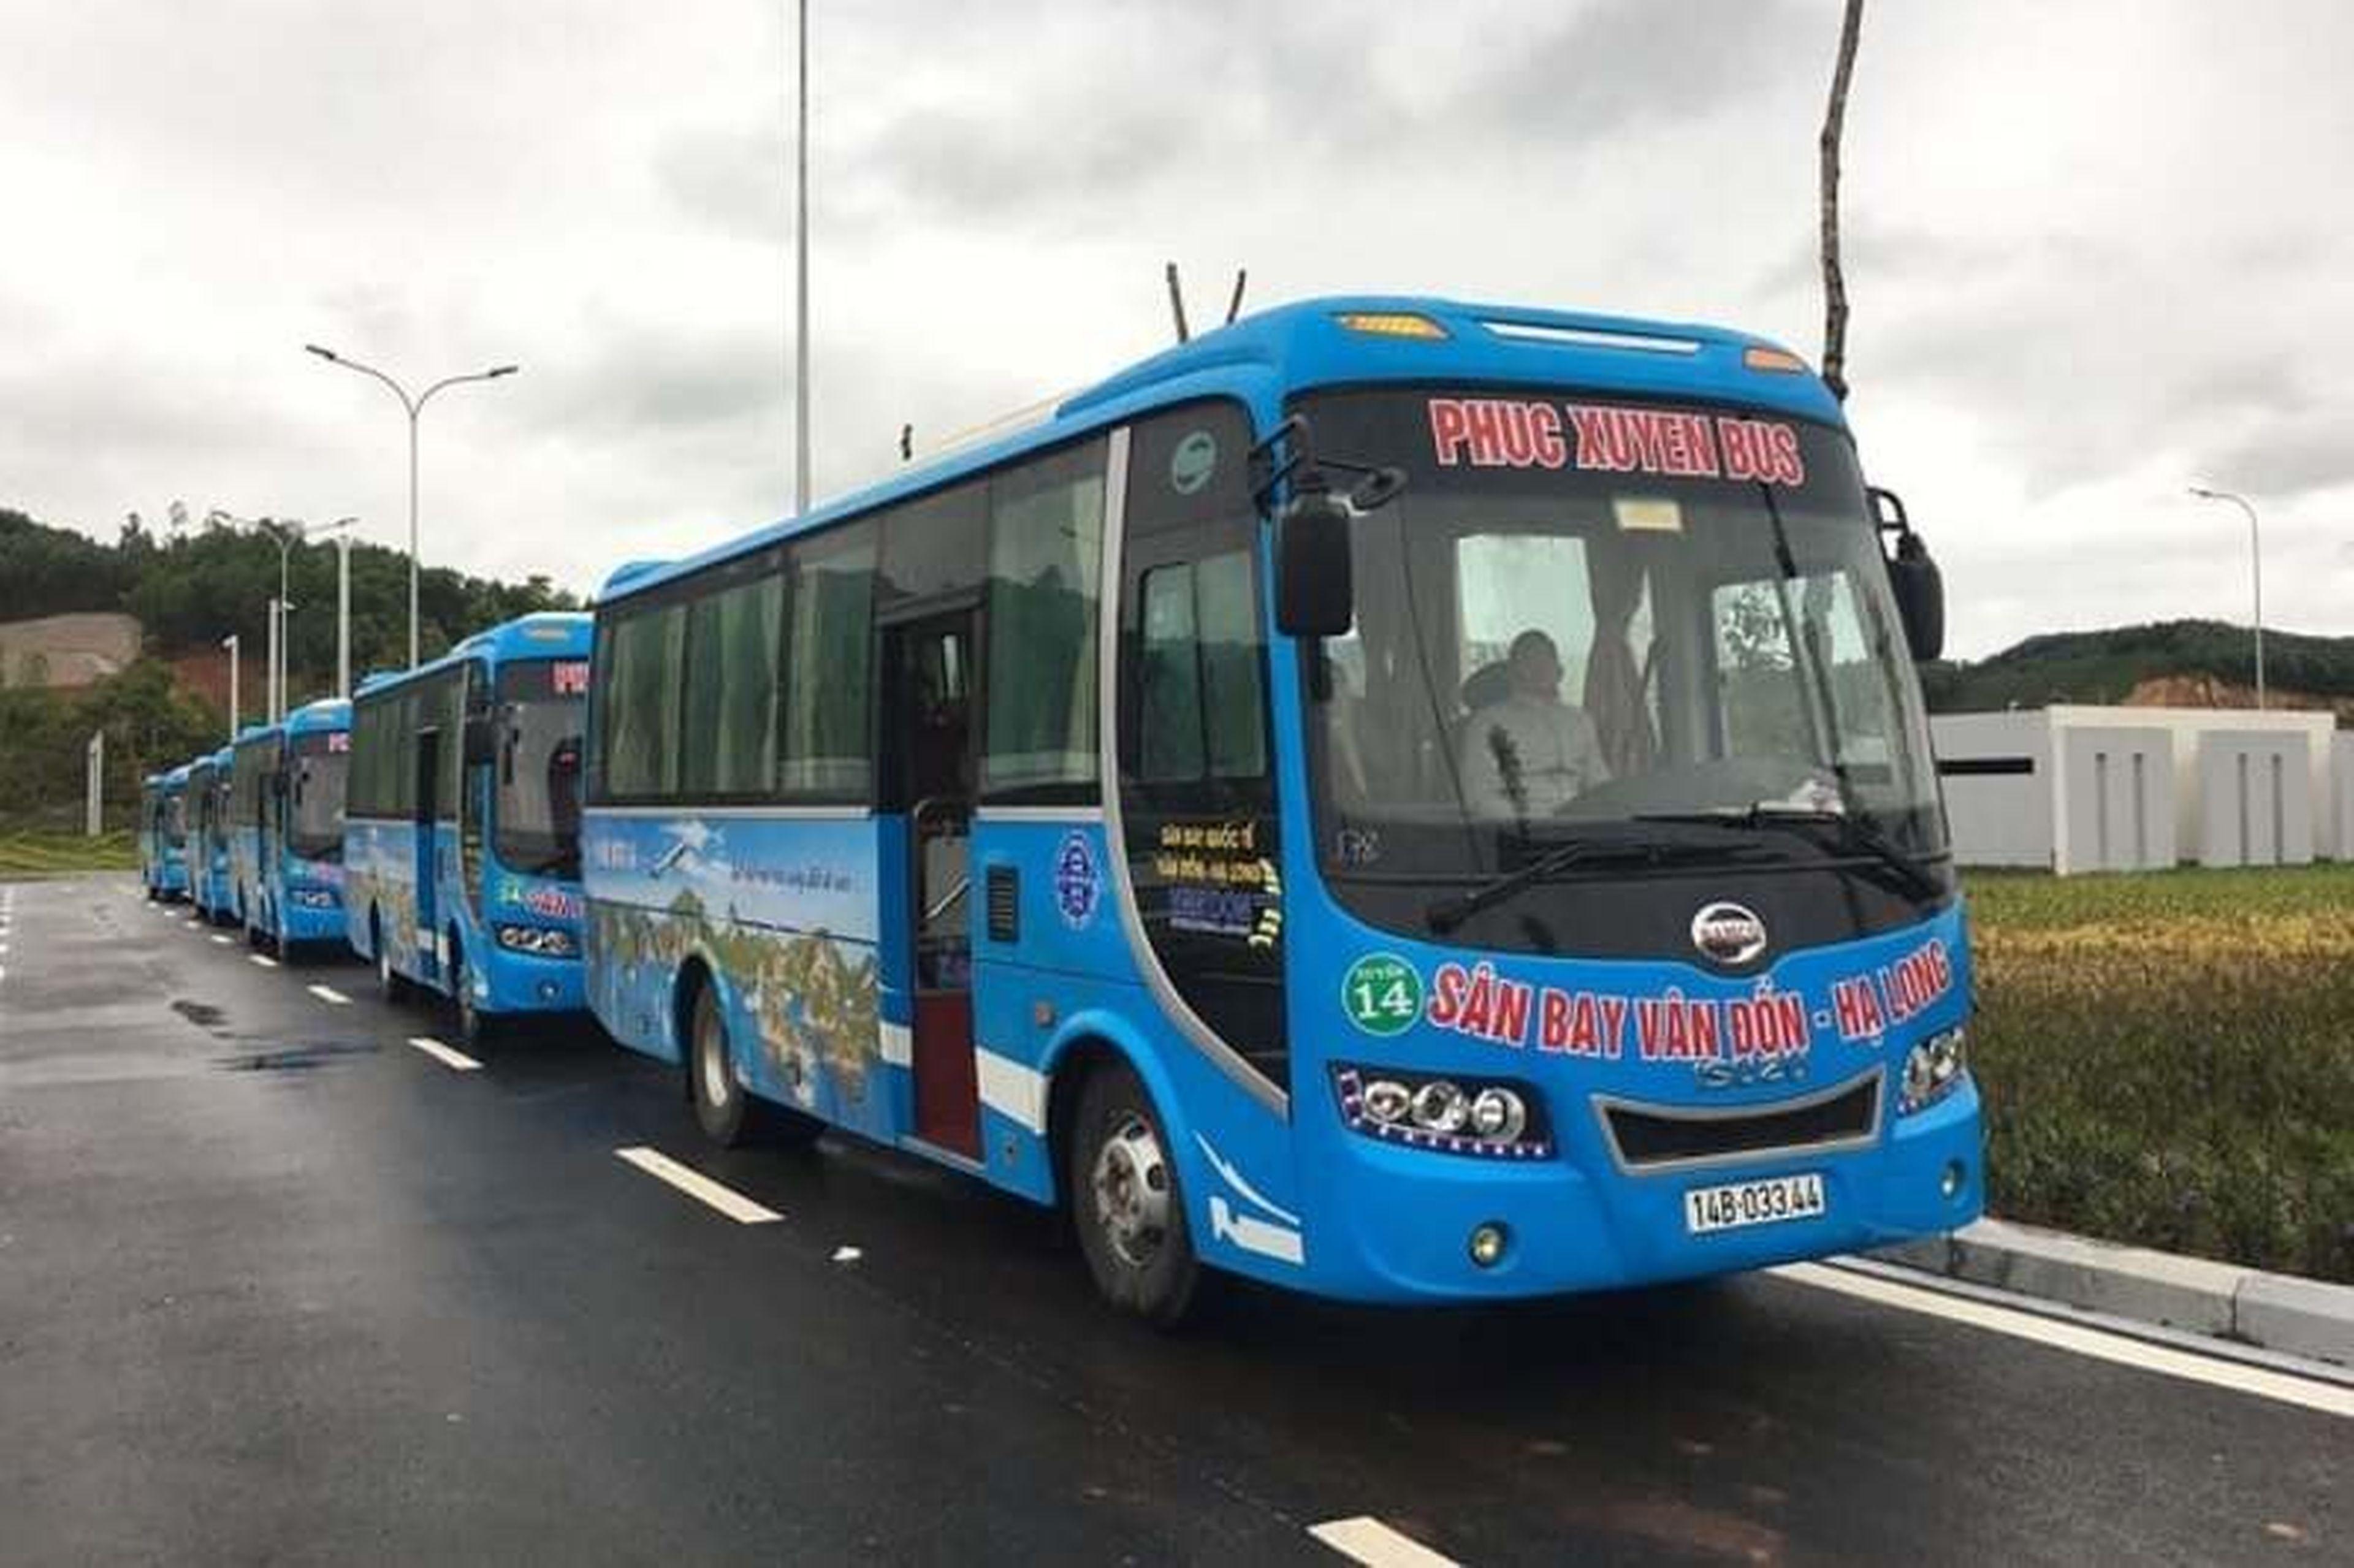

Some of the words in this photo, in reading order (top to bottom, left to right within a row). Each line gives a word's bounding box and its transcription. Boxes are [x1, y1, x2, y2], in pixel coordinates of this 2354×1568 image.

[1429, 400, 1566, 468] PHUC
[1566, 405, 1718, 478] XUYEN
[1717, 418, 1804, 486] BUS
[1355, 979, 1413, 1019] 14
[1427, 961, 1533, 1049] SÂN
[1538, 988, 1628, 1060] BAY
[1633, 986, 1723, 1061] VÂN
[1832, 973, 1886, 1047] HẠ
[1876, 938, 1953, 1025] LONG
